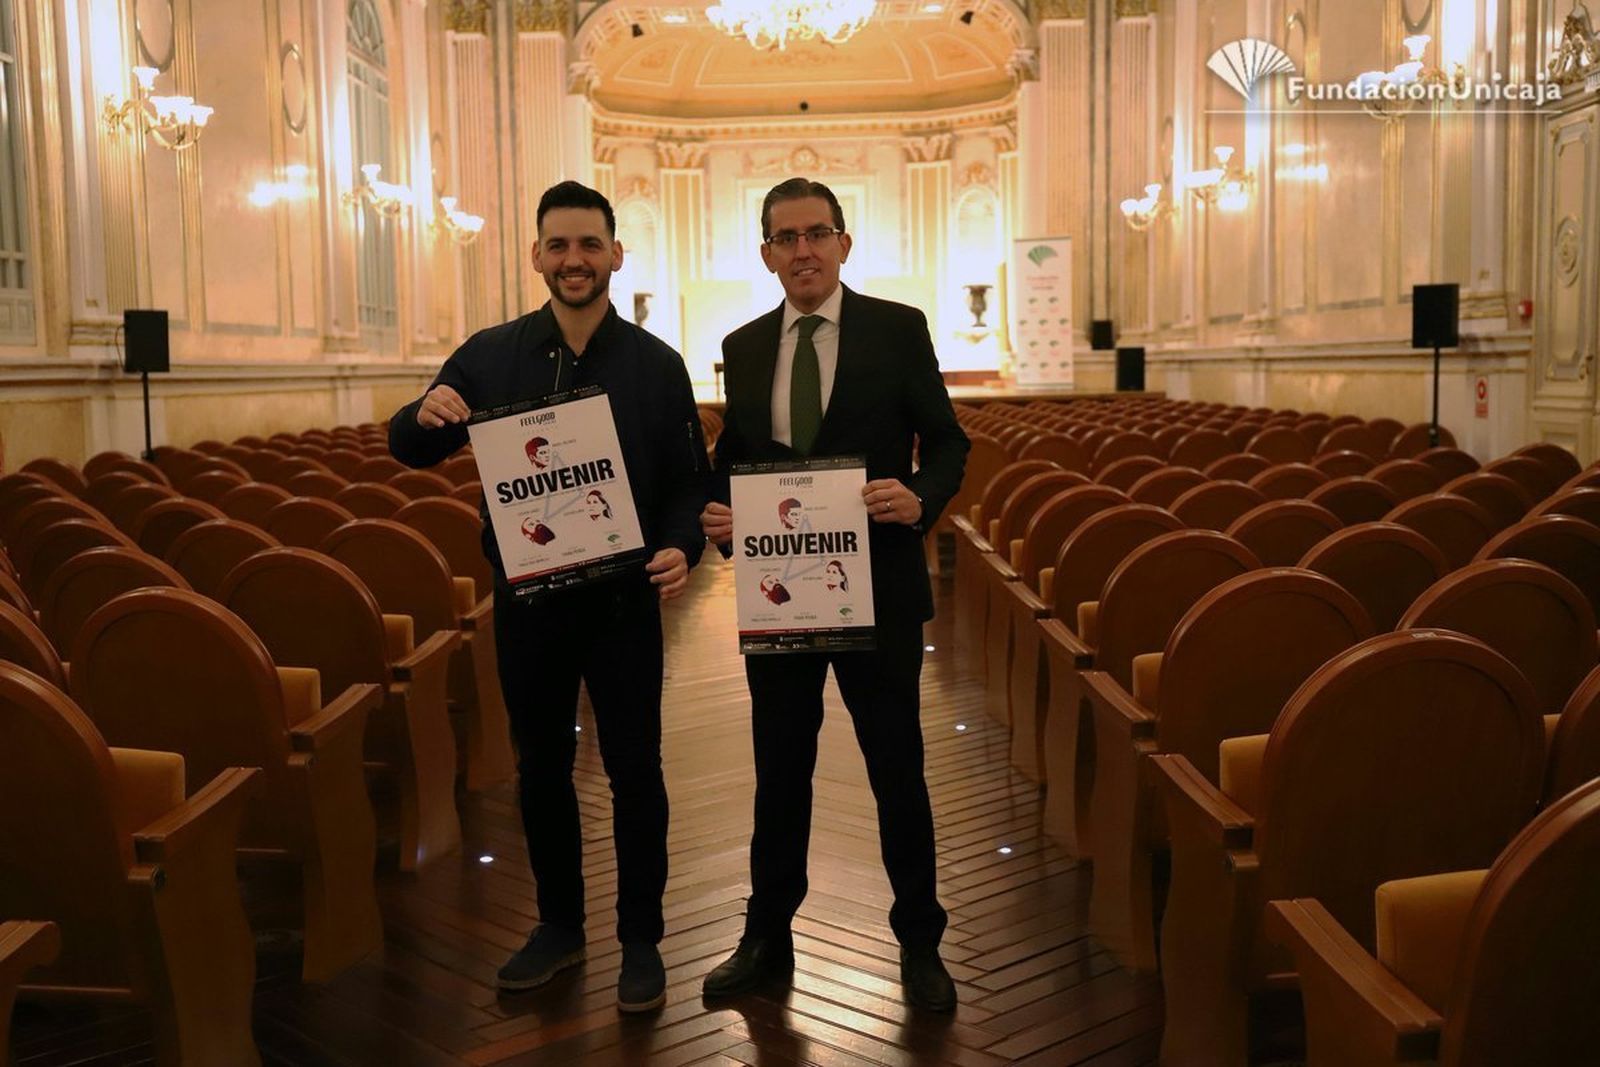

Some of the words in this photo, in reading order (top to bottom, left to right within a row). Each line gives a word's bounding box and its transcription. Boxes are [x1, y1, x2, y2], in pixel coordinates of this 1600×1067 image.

[520, 411, 556, 427] FEELGOOD
[496, 458, 615, 504] SOUVENIR
[744, 531, 857, 557] SOUVENIR
